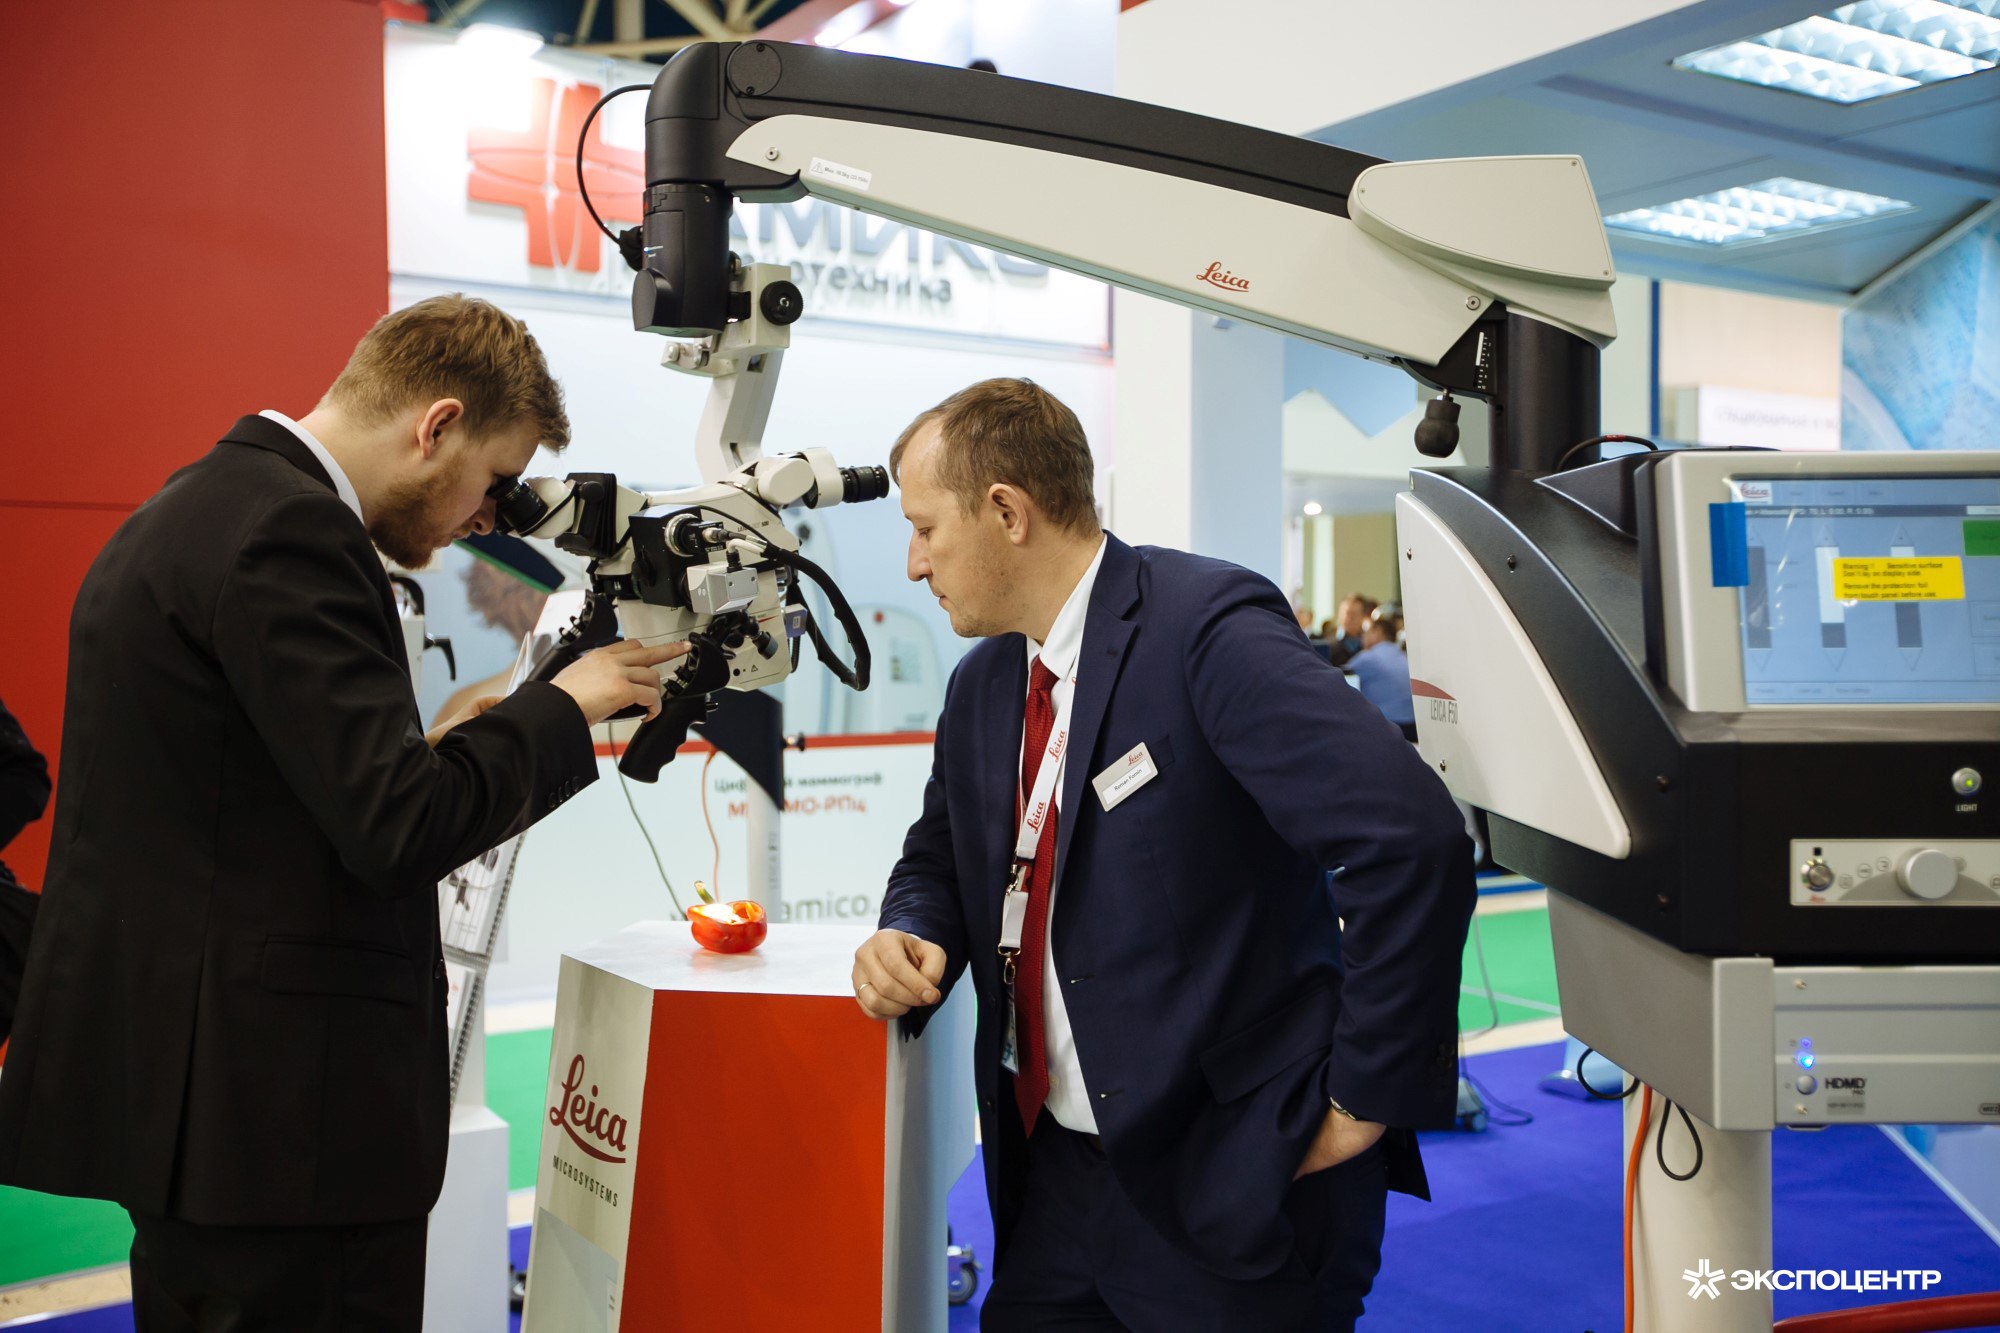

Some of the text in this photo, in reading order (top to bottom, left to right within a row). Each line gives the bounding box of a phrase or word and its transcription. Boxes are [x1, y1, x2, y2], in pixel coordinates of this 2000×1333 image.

[729, 203, 1050, 278] МИК
[1196, 261, 1250, 292] Leica
[1430, 699, 1459, 725] LEICA F50
[1049, 730, 1067, 763] Leica
[1127, 751, 1144, 767] Leica
[1114, 777, 1129, 792] Roman
[1027, 801, 1047, 835] Leica
[1955, 803, 1978, 812] LIGHT
[1825, 1077, 1866, 1089] HDMD
[549, 1054, 628, 1164] Leica
[553, 1155, 619, 1207] MICROSYSTEMS
